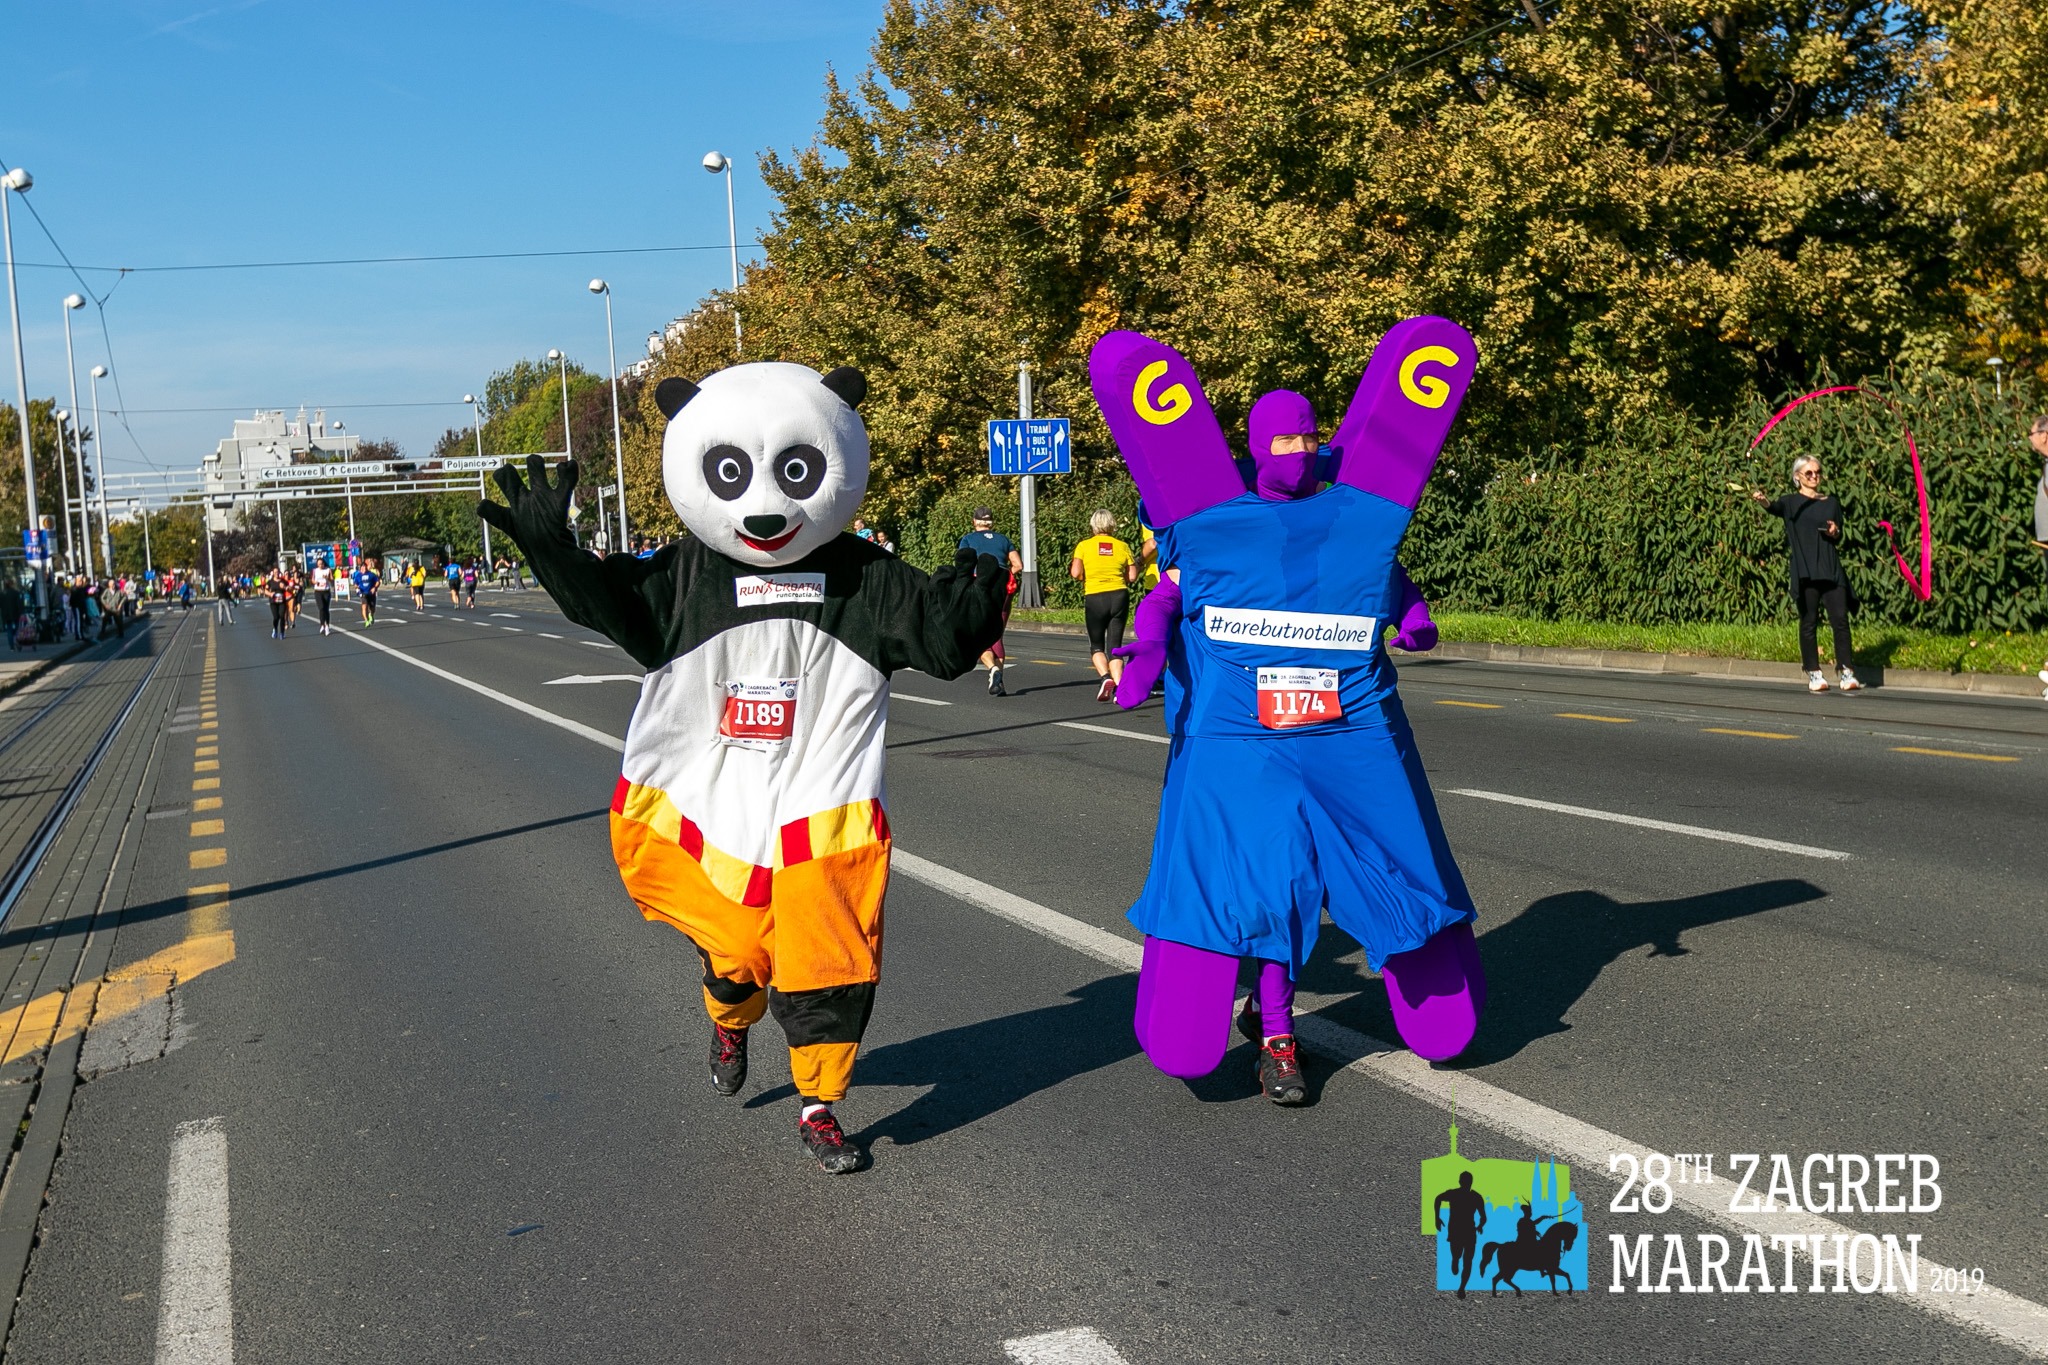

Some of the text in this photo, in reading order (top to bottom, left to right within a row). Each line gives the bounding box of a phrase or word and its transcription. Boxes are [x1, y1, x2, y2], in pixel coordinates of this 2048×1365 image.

[1399, 345, 1460, 409] G
[1132, 360, 1193, 426] G
[1030, 425, 1049, 434] TRAM
[1032, 436, 1046, 445] BUS
[1031, 447, 1048, 456] TAXI
[340, 465, 370, 474] Centar
[447, 459, 487, 470] Poljanice
[276, 468, 318, 477] Retkovec
[775, 582, 823, 593] CROATIA
[1209, 615, 1368, 643] #rarebutnotalone
[1272, 692, 1326, 715] 1174
[734, 701, 785, 726] 1189
